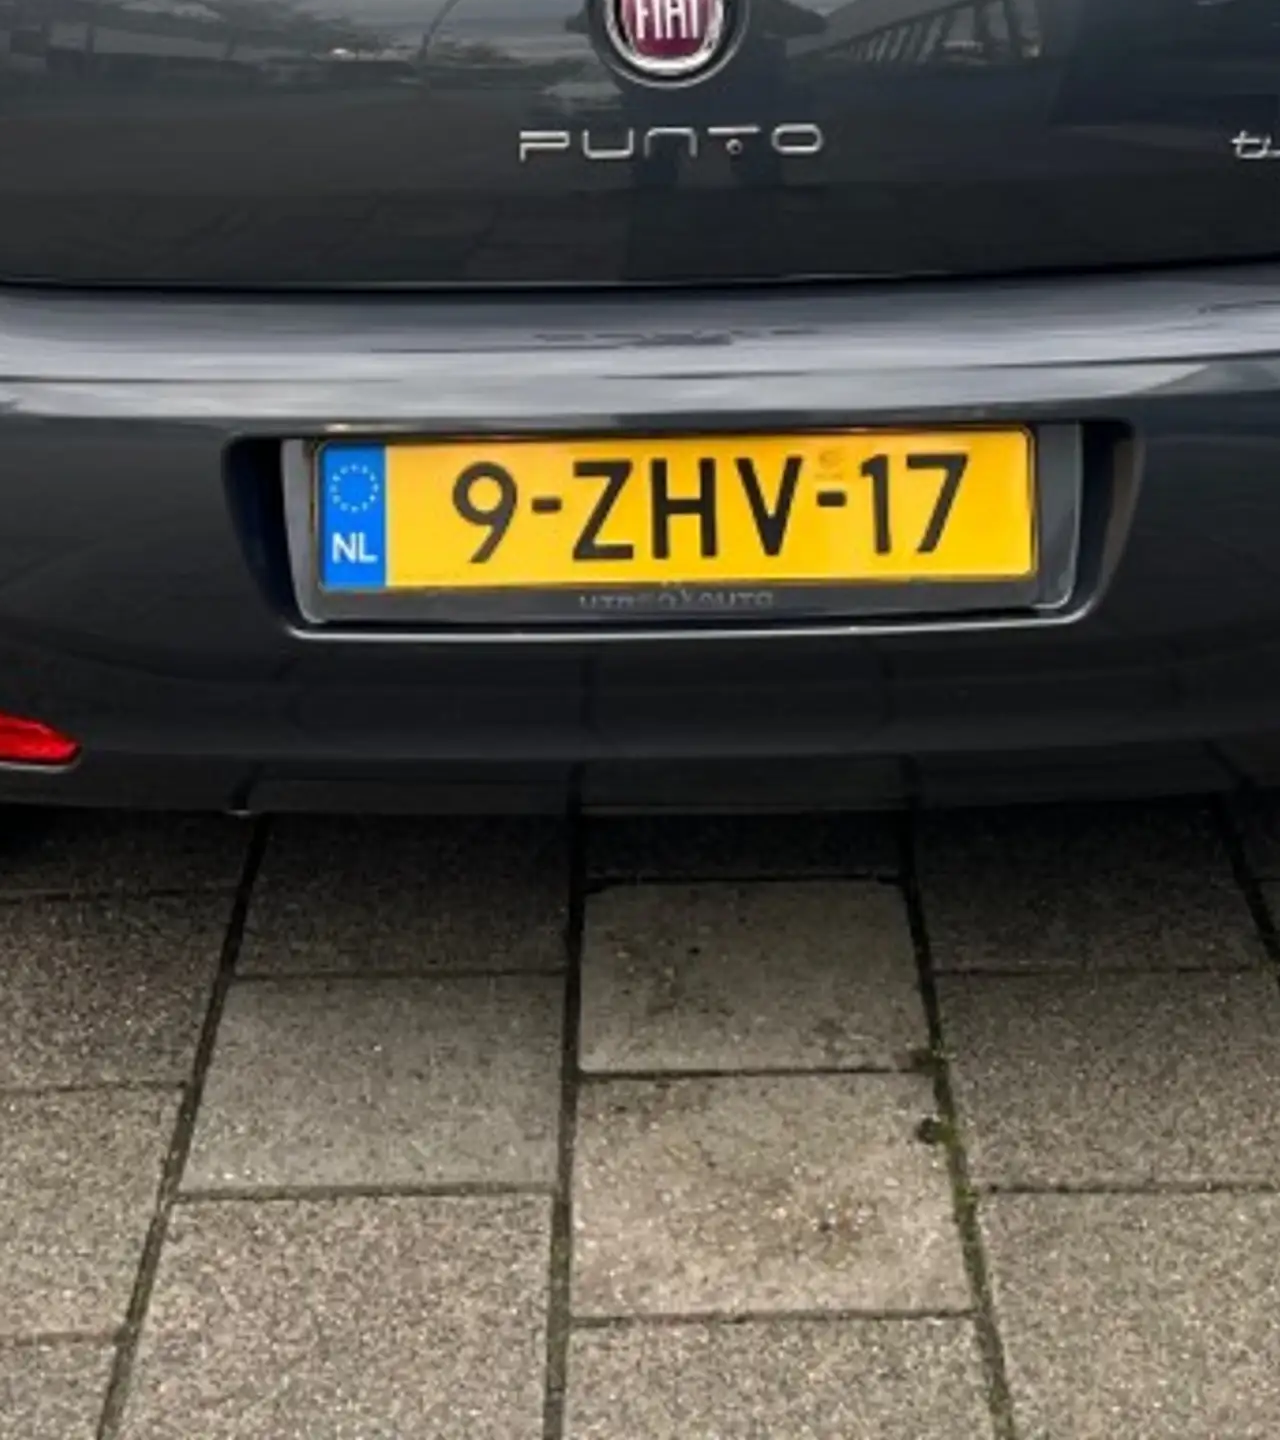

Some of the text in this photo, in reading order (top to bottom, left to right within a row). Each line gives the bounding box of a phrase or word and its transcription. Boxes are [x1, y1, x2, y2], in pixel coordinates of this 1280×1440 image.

[519, 122, 824, 162] PUNTO
[452, 453, 970, 565] 9-ZHV-17
[331, 532, 378, 565] NL
